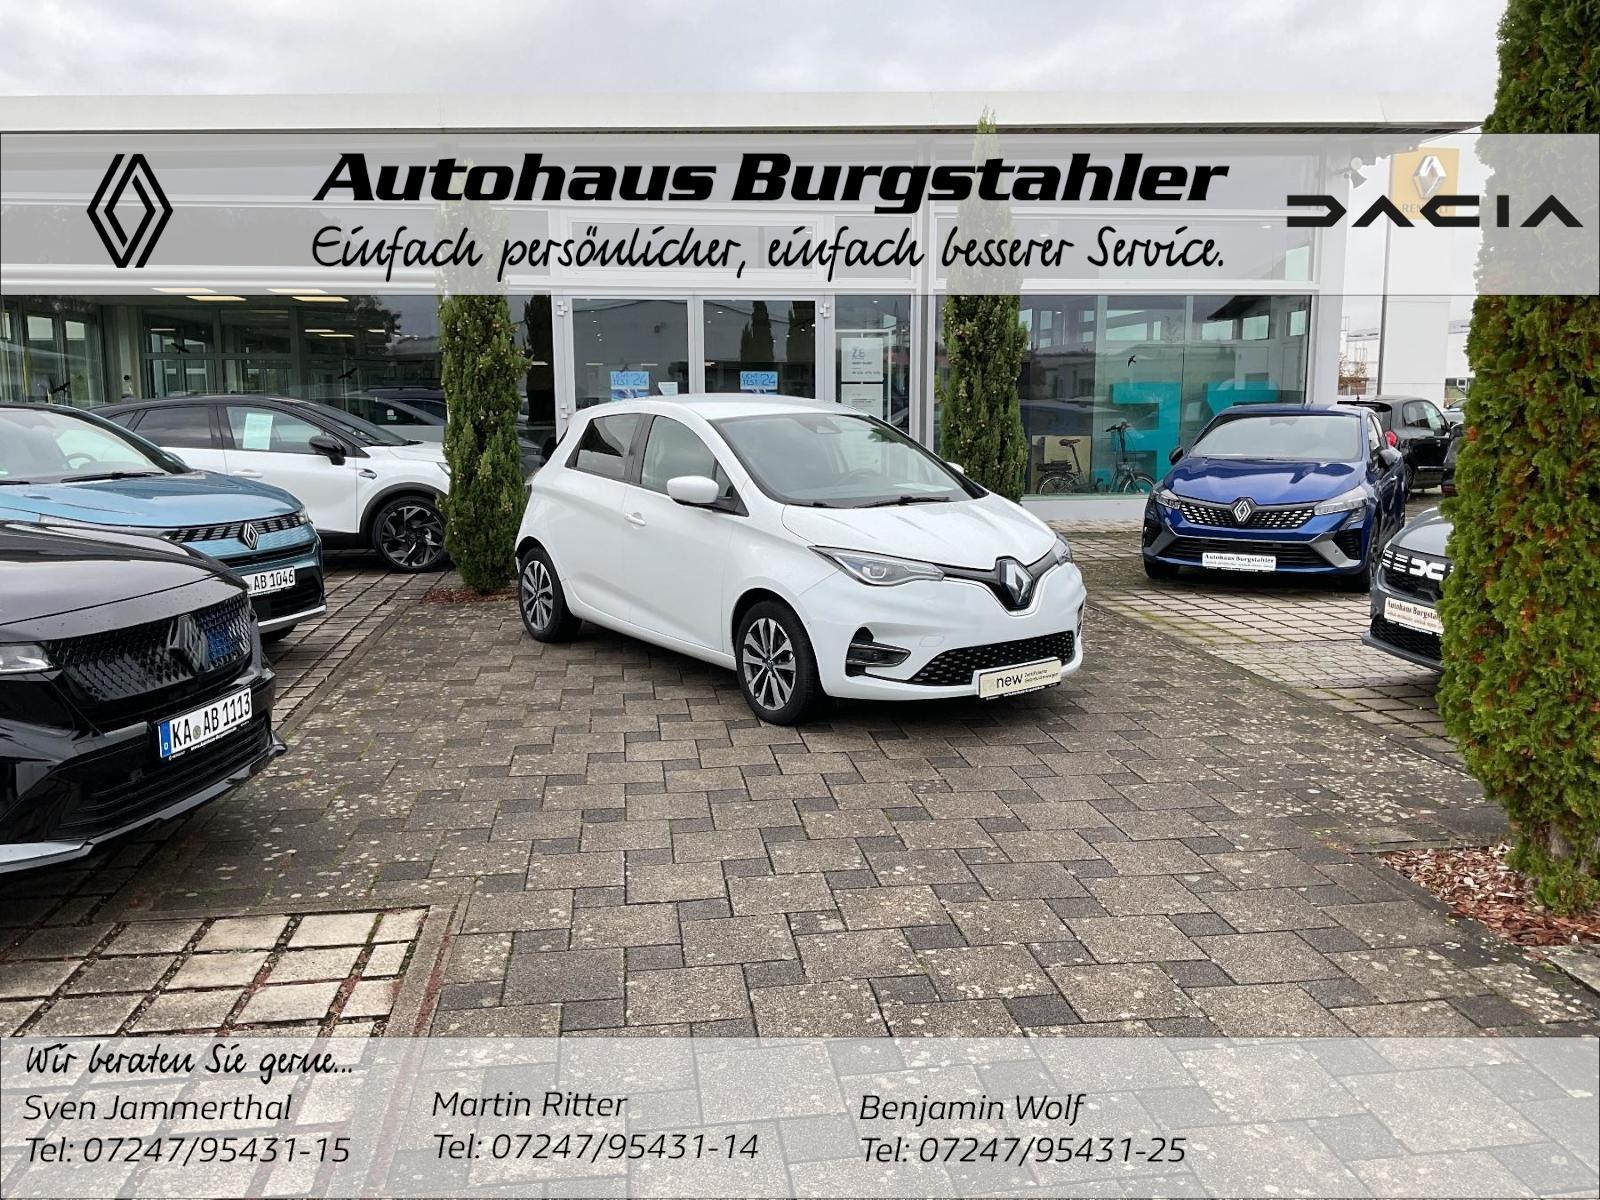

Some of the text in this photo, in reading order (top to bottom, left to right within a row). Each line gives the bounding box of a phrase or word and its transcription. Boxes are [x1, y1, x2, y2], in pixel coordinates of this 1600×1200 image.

[1402, 203, 1448, 214] RENLT
[254, 569, 294, 590] AB 1046
[996, 673, 1023, 689] new
[172, 719, 193, 749] KA
[203, 707, 219, 735] AB
[222, 692, 250, 727] 1113
